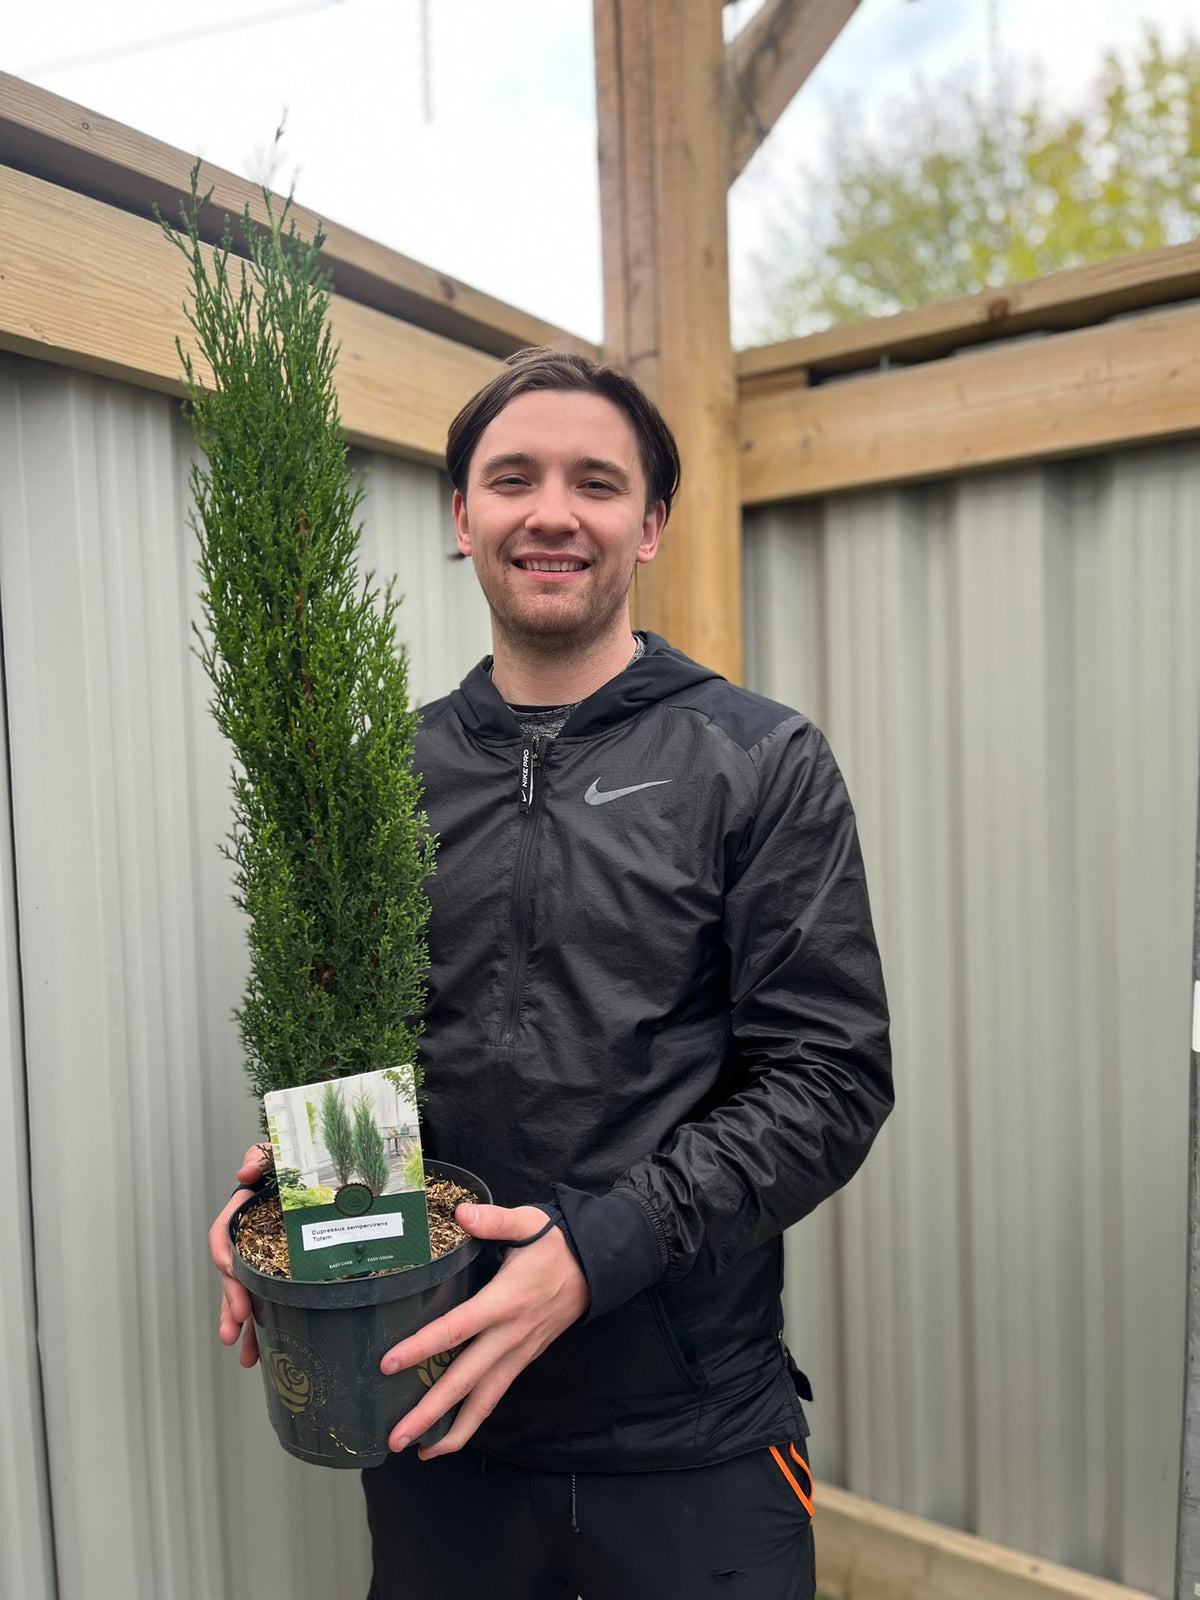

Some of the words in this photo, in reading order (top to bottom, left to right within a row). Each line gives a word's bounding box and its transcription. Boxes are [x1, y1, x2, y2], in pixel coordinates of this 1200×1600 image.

[311, 1227, 345, 1236] Cupressus
[347, 1221, 388, 1230] sempervirens
[312, 1235, 333, 1243] Totem
